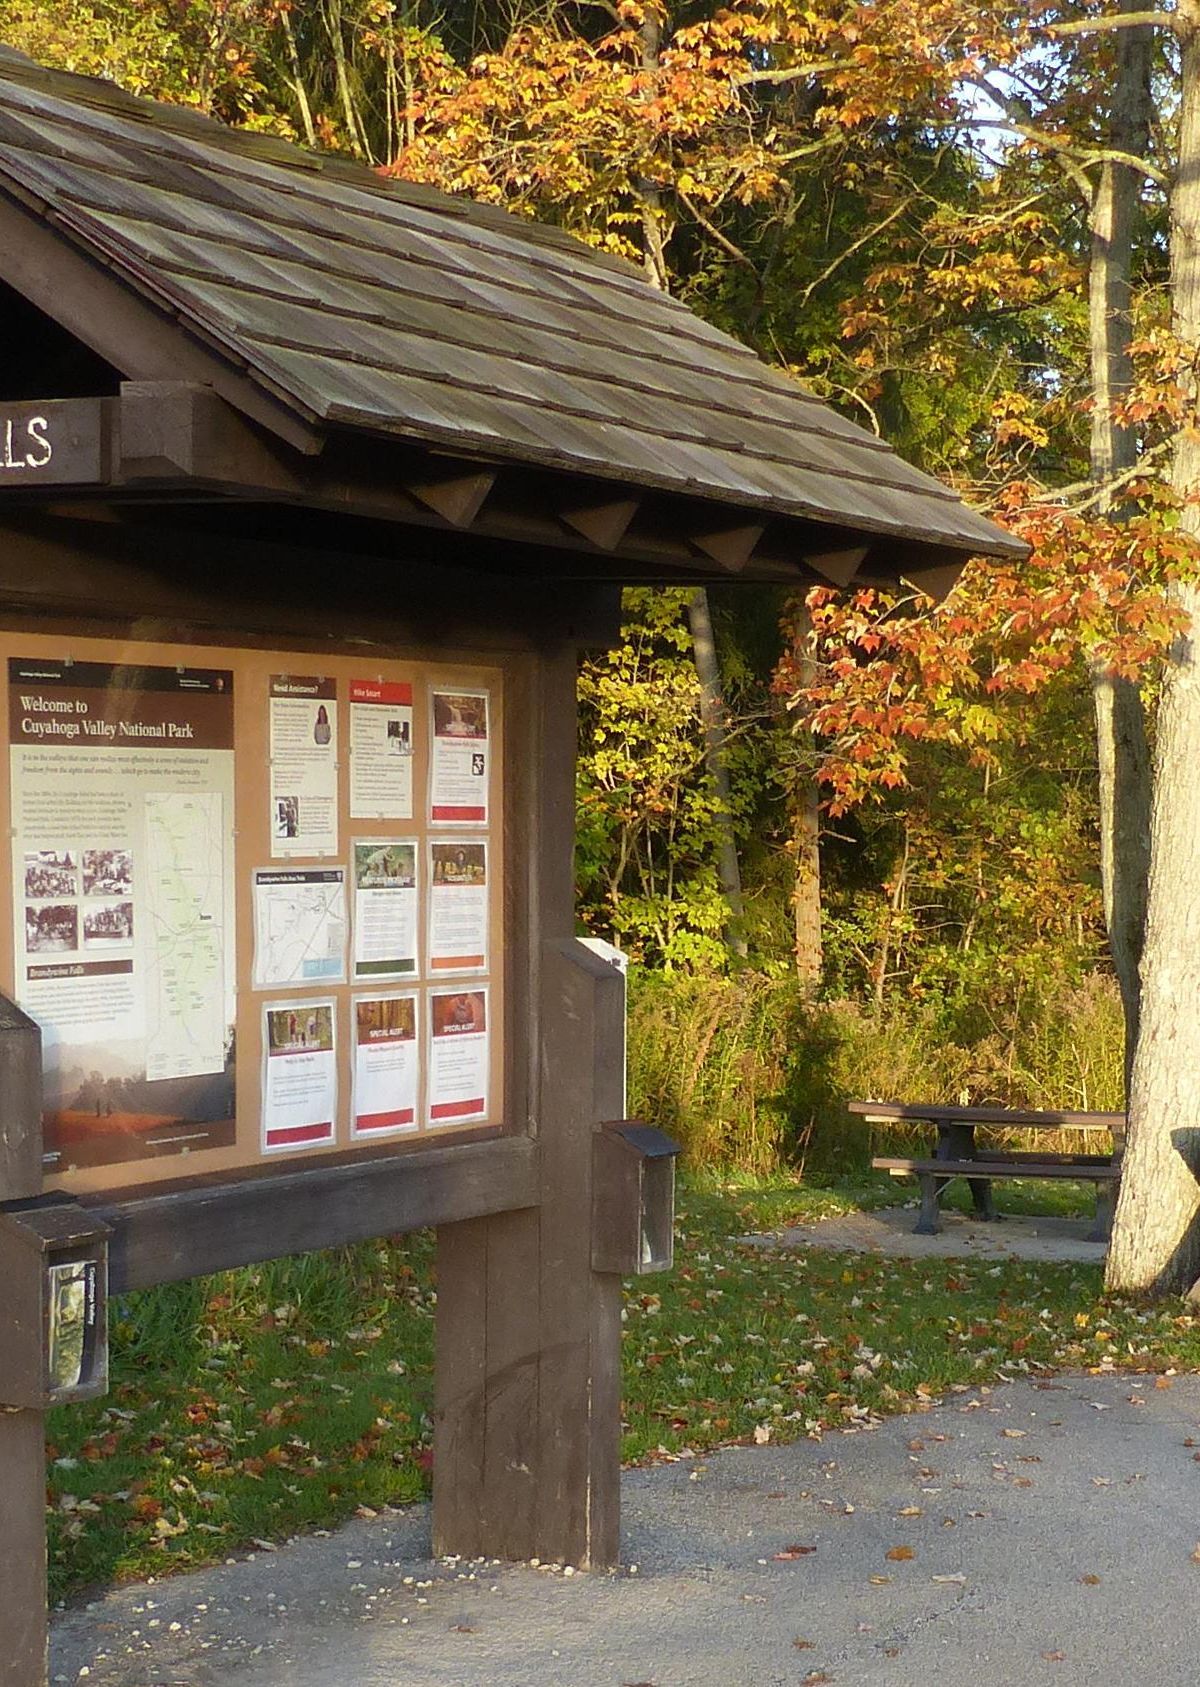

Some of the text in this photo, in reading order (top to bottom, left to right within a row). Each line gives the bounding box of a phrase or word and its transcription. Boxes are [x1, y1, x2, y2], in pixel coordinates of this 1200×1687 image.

[0, 417, 52, 468] LS
[20, 696, 88, 713] Welcome to
[22, 718, 193, 739] Cuyahoga Valley National Park
